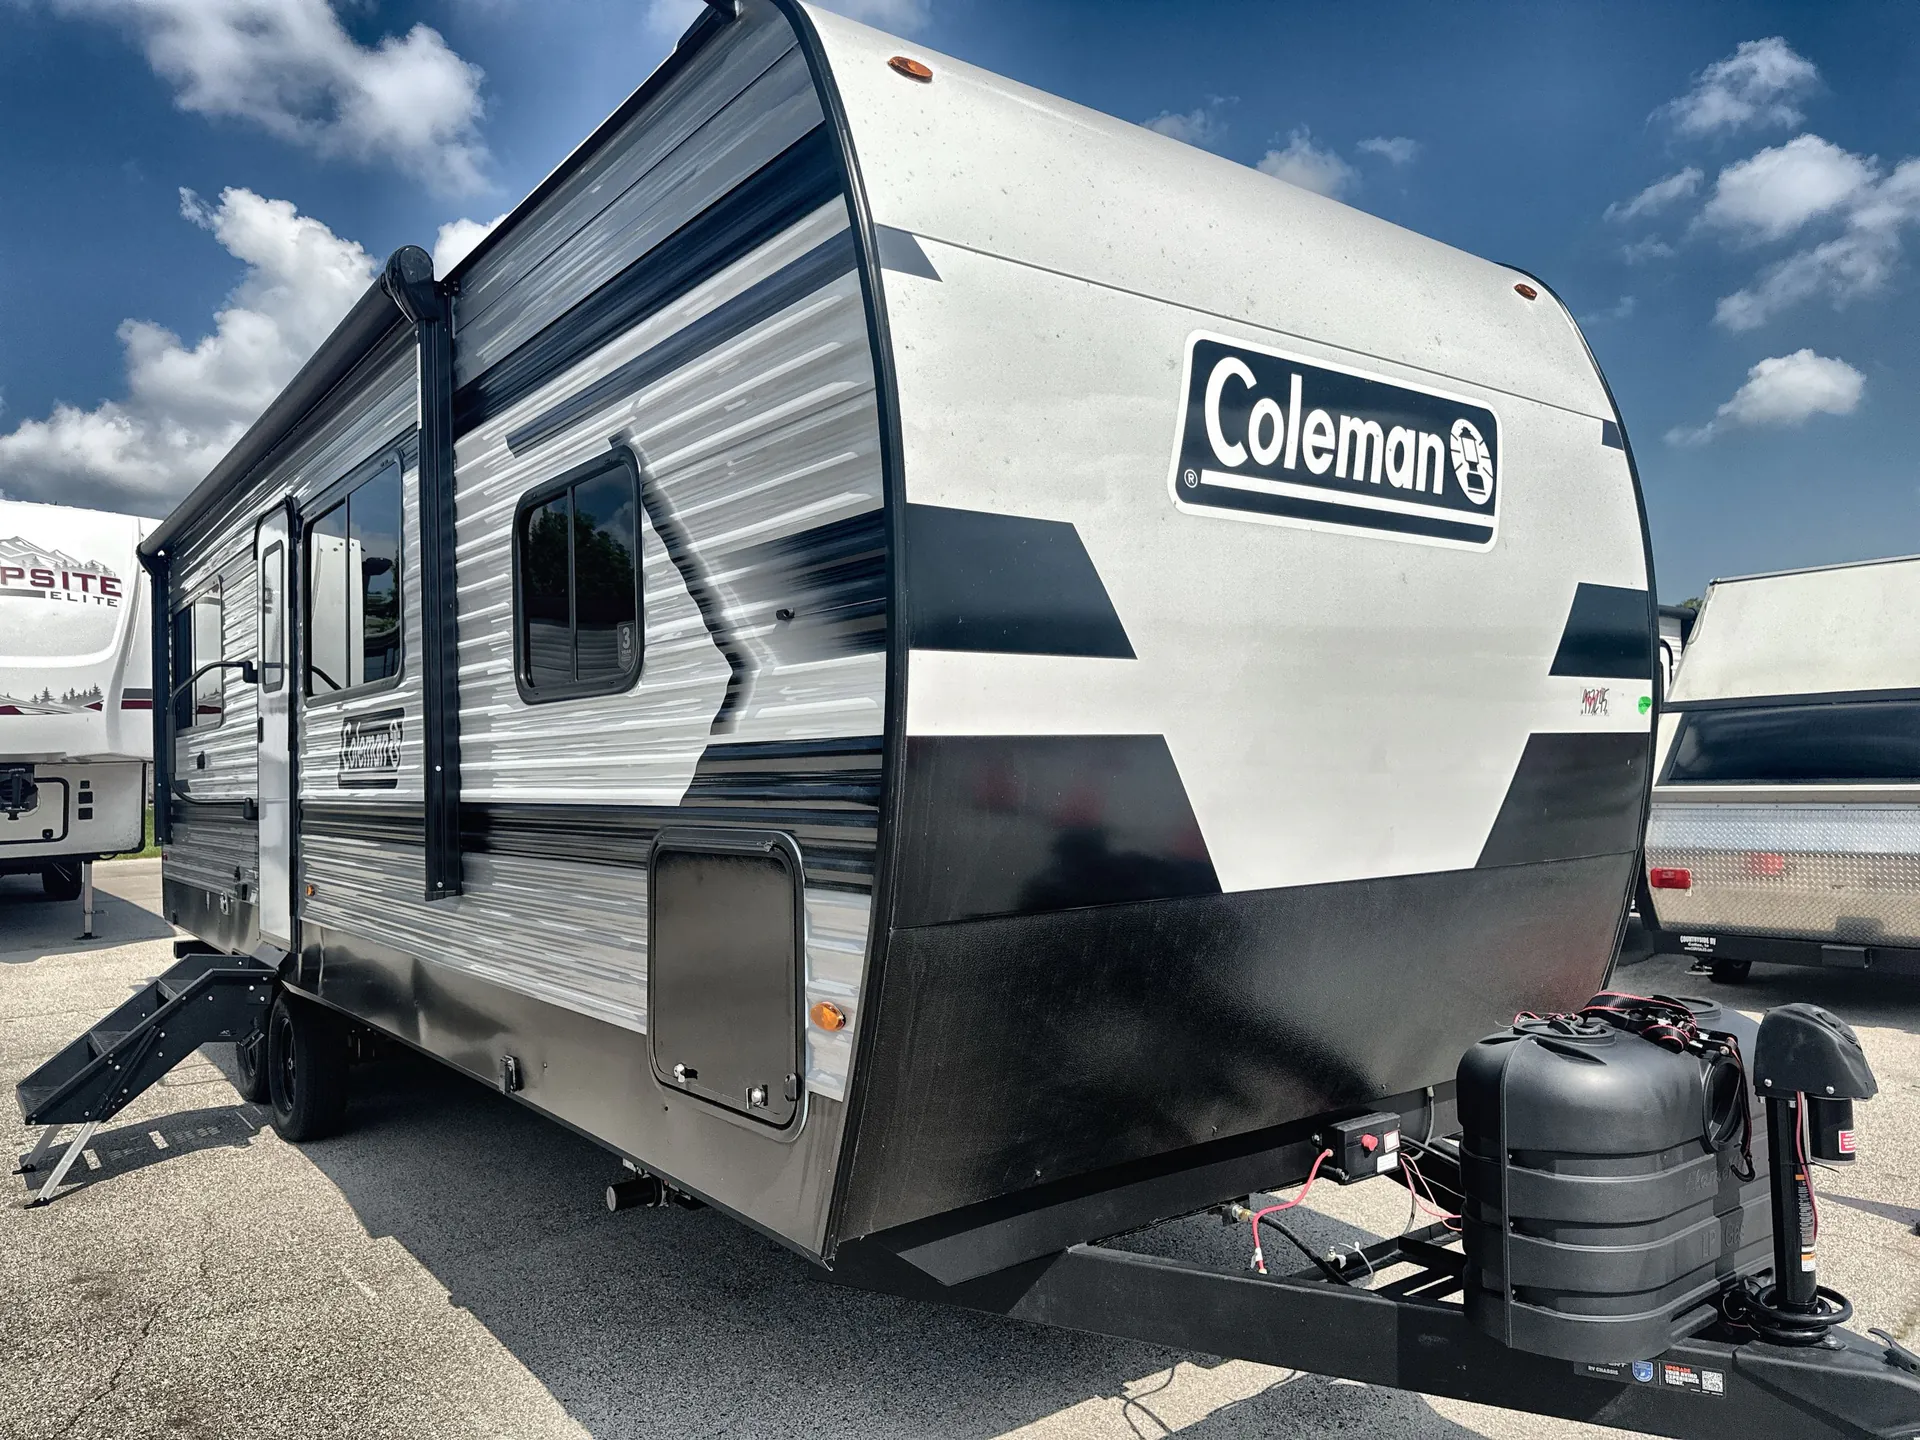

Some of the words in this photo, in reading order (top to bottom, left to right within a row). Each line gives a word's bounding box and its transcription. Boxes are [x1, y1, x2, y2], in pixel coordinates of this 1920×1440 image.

[1204, 356, 1445, 495] Coleman
[0, 566, 122, 598] PSITE
[50, 591, 118, 607] ELITE
[623, 627, 630, 649] 3
[341, 721, 389, 772] Coleman
[1596, 1367, 1619, 1375] CHASSIS
[1664, 1364, 1692, 1373] UPGRADE
[1665, 1374, 1700, 1384] EXPERIENCE
